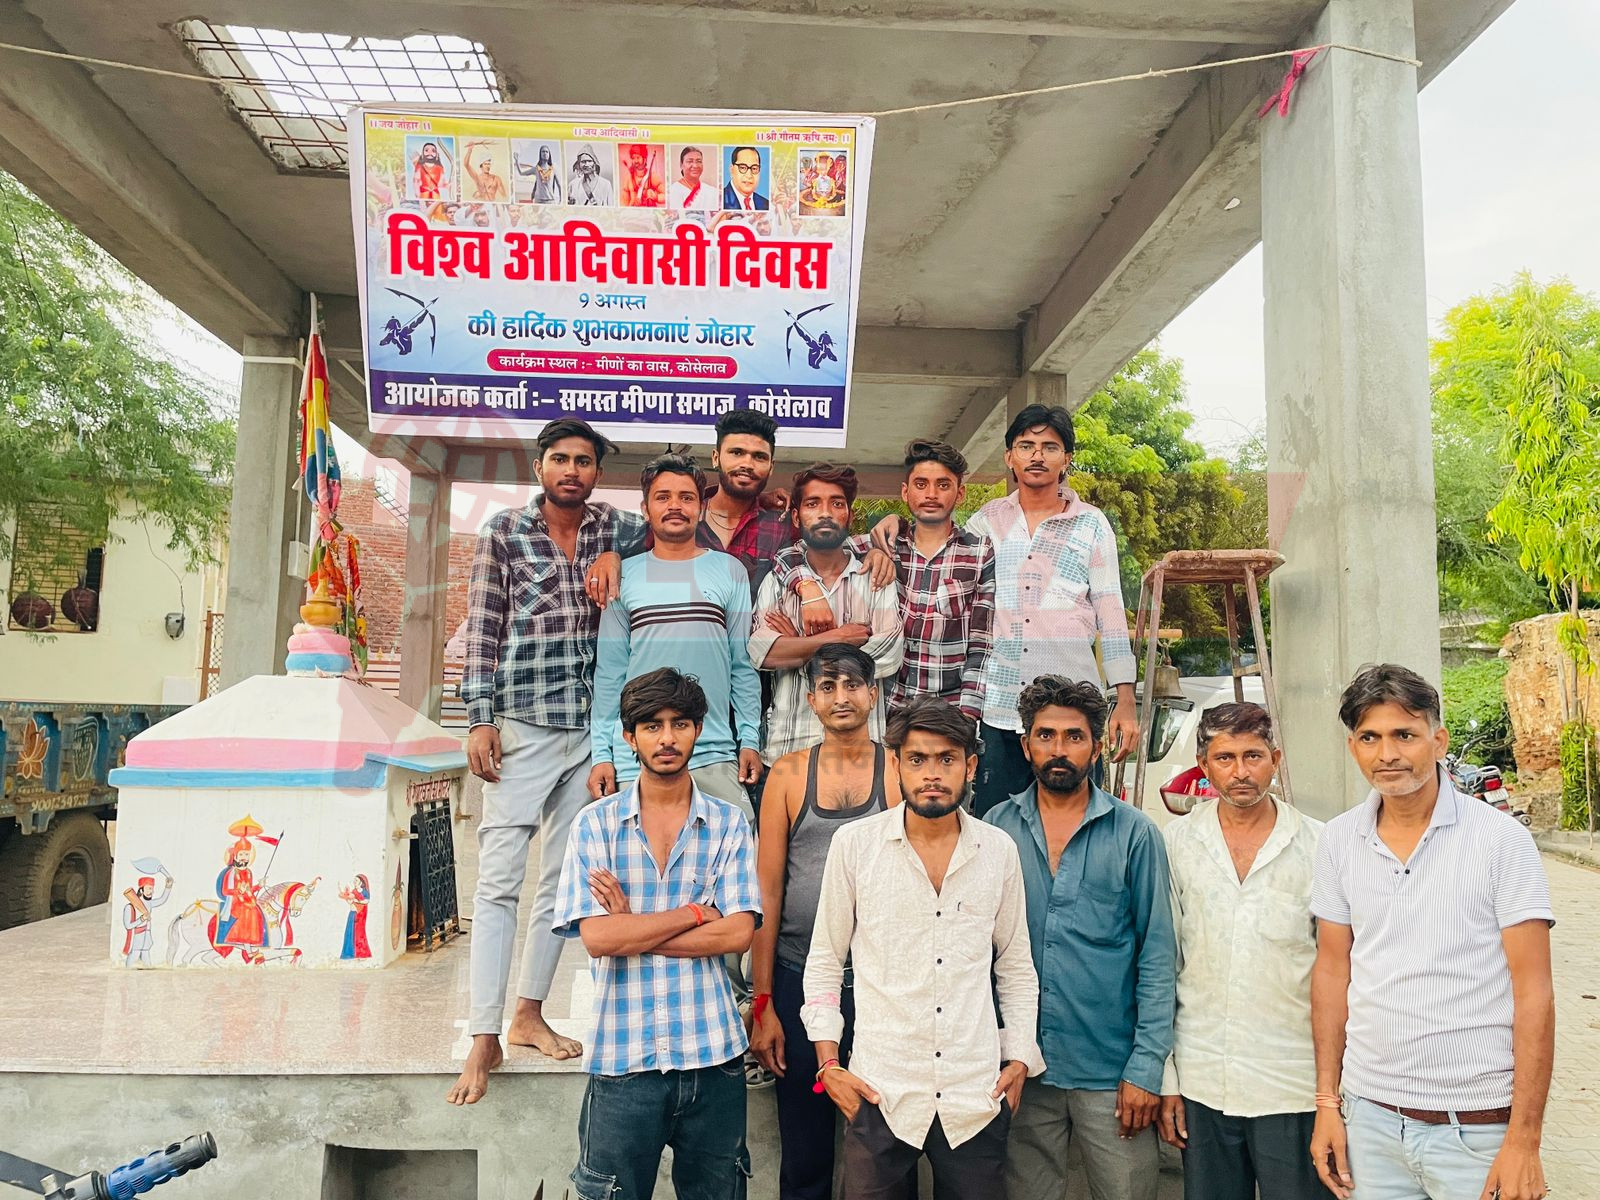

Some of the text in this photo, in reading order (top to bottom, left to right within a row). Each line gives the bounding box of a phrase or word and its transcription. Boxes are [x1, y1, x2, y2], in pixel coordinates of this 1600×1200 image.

[395, 119, 419, 130] जोहार
[599, 127, 638, 138] आदिवासी
[387, 213, 832, 289] विश्व आदिवासी दिवस
[595, 294, 646, 310] अगस्त
[467, 309, 756, 346] की हार्दिक शुभकामनाएं जोहार
[498, 352, 545, 369] कार्यक्रम
[549, 358, 578, 370] स्थल
[595, 356, 624, 371] मीणों
[626, 360, 643, 371] का
[646, 361, 674, 373] वास,
[676, 359, 728, 374] कोसेलाव
[384, 377, 481, 408] आयोजक
[483, 380, 528, 409] कर्ता
[559, 388, 618, 413] समस्त
[621, 384, 674, 415] मीणा
[675, 392, 736, 416] समाज
[747, 388, 832, 419] कोसेलाव
